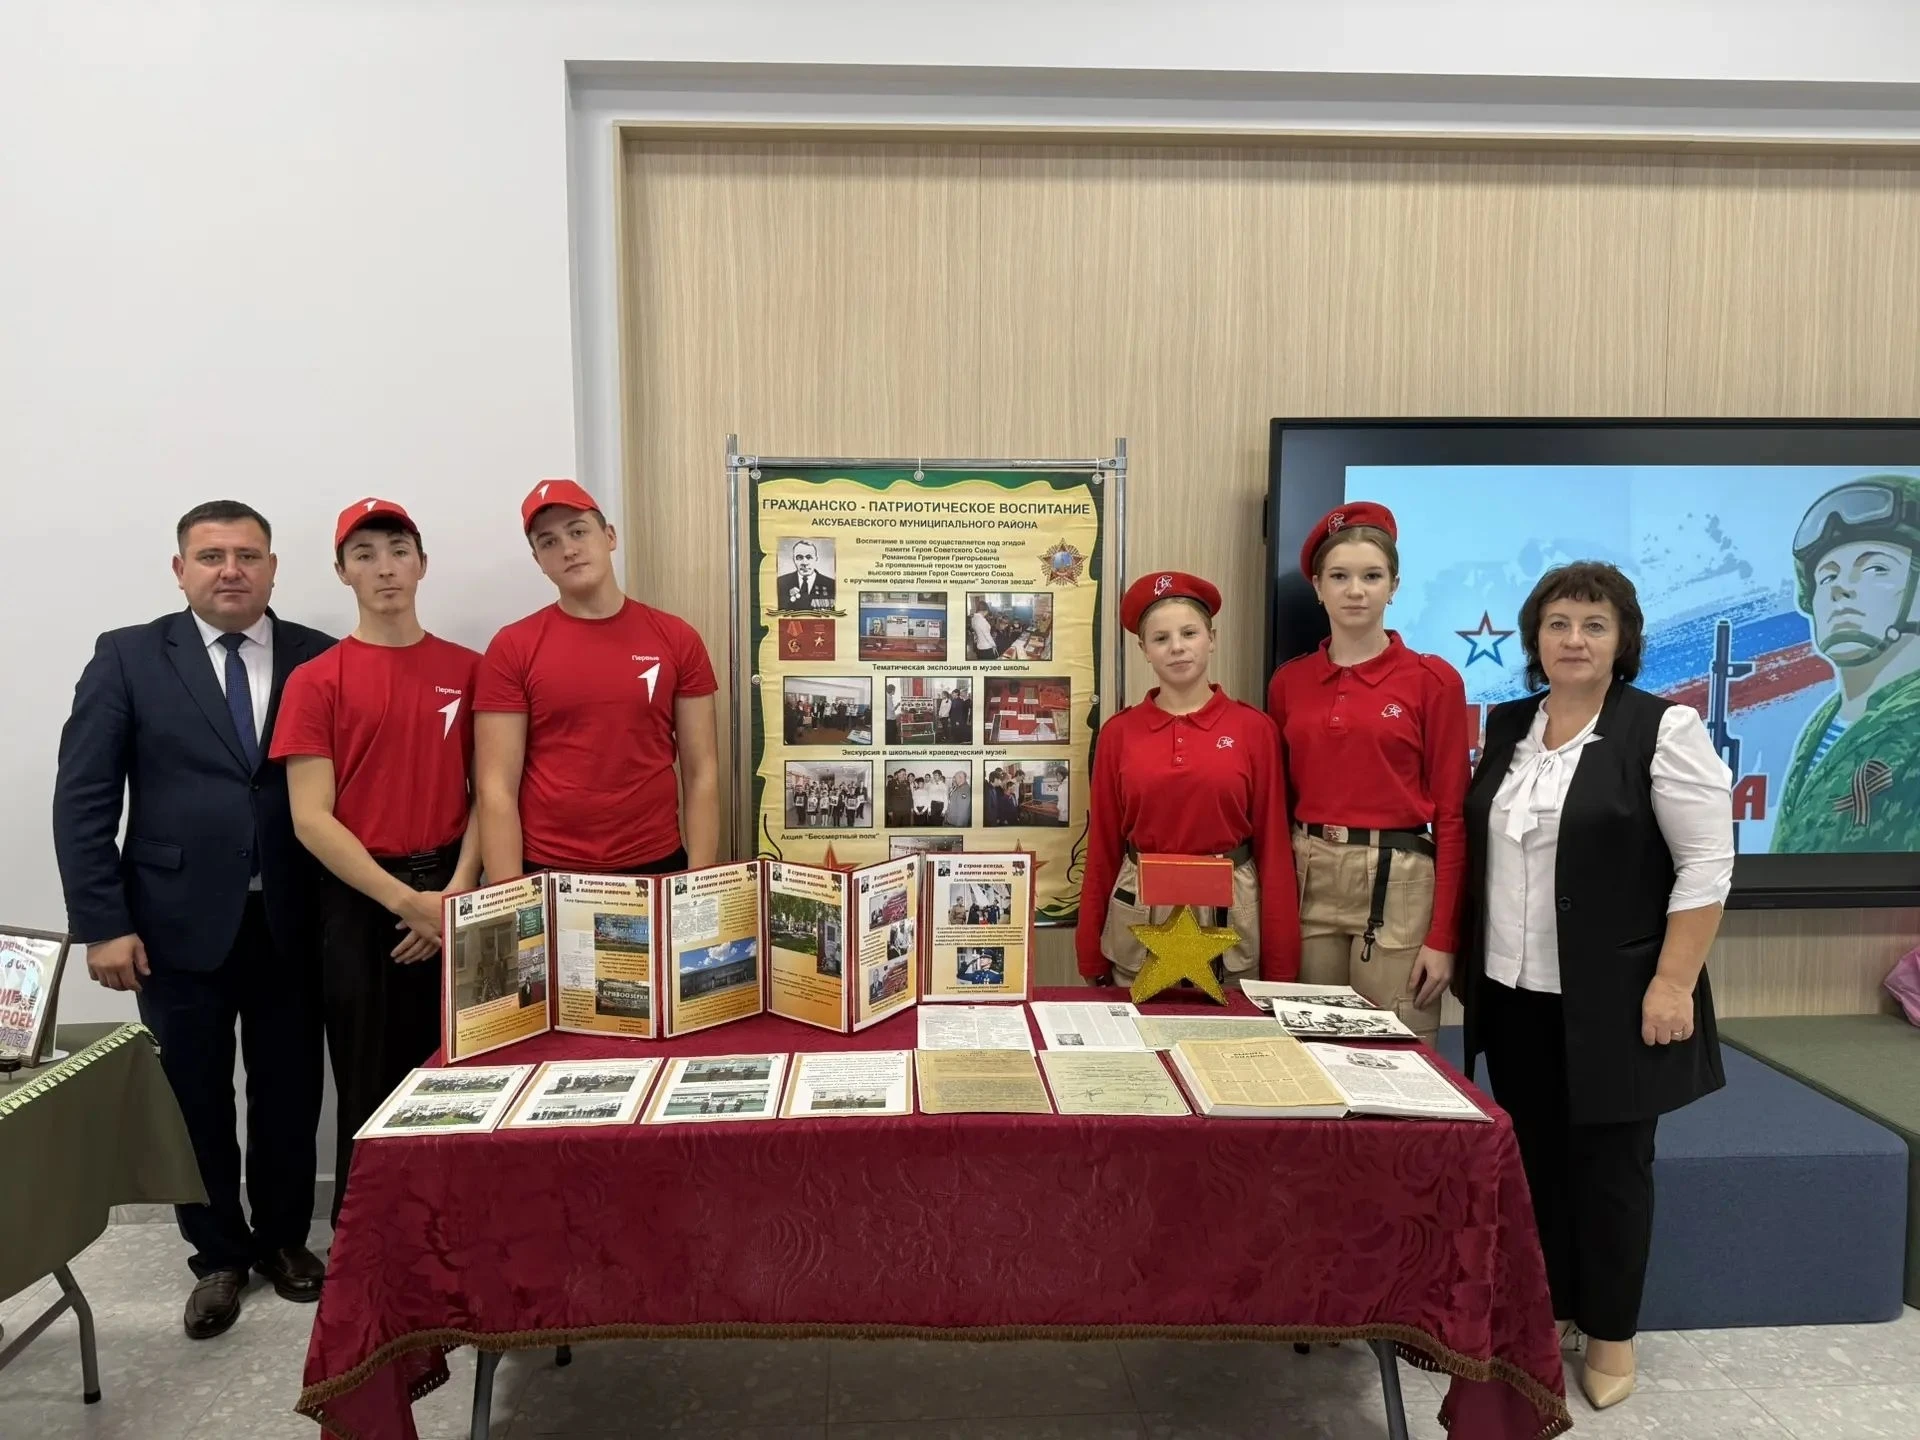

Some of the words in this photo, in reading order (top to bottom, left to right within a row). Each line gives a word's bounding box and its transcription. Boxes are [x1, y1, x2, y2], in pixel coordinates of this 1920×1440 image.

[763, 499, 857, 512] ГРАЖДАНСКО
[869, 501, 995, 514] ПАТРИОТИЧЕСКОЕ
[1000, 503, 1090, 514] ВОСПИТАНИЕ
[811, 518, 896, 528] АКСУБАЕВСКОГО
[900, 519, 995, 529] МУНИЦИПАЛЬНОГО
[998, 519, 1038, 529] РАЙОНА
[926, 664, 971, 672] экспозиция
[435, 686, 462, 695] Первые
